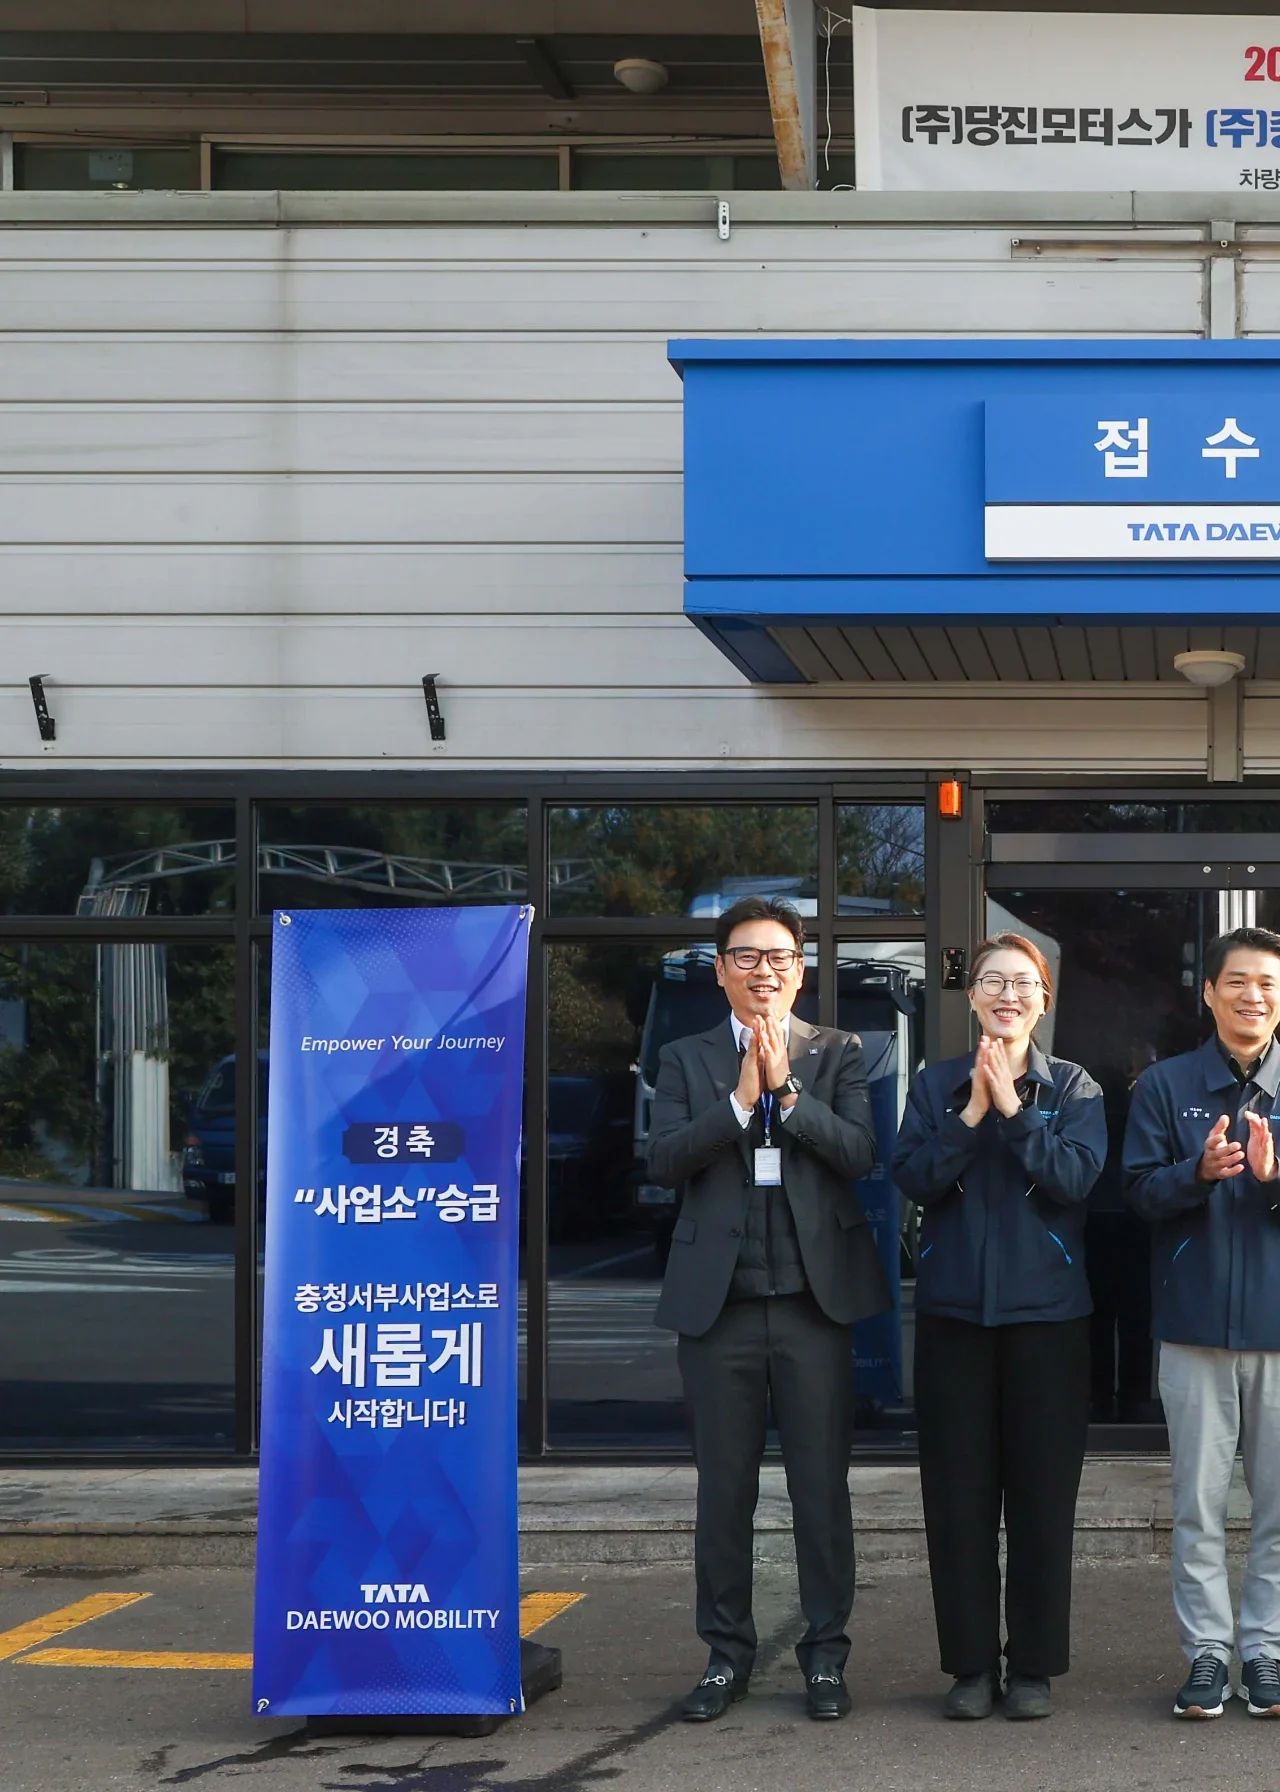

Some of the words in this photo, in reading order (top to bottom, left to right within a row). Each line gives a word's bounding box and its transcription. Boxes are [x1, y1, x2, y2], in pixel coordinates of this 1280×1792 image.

[901, 104, 1193, 149] (주)당진모터스가
[1127, 522, 1200, 542] TATA
[300, 1035, 385, 1055] Empower
[391, 1034, 433, 1051] Your
[437, 1034, 506, 1053] Journey
[372, 1125, 435, 1159] 경축
[293, 1282, 499, 1313] 충청서부사업소로
[309, 1322, 482, 1388] 새롭게
[326, 1397, 466, 1429] 시작합니다!
[360, 1583, 430, 1603] TATA
[286, 1609, 390, 1631] DAEWOO
[394, 1608, 500, 1630] MOBILITY
